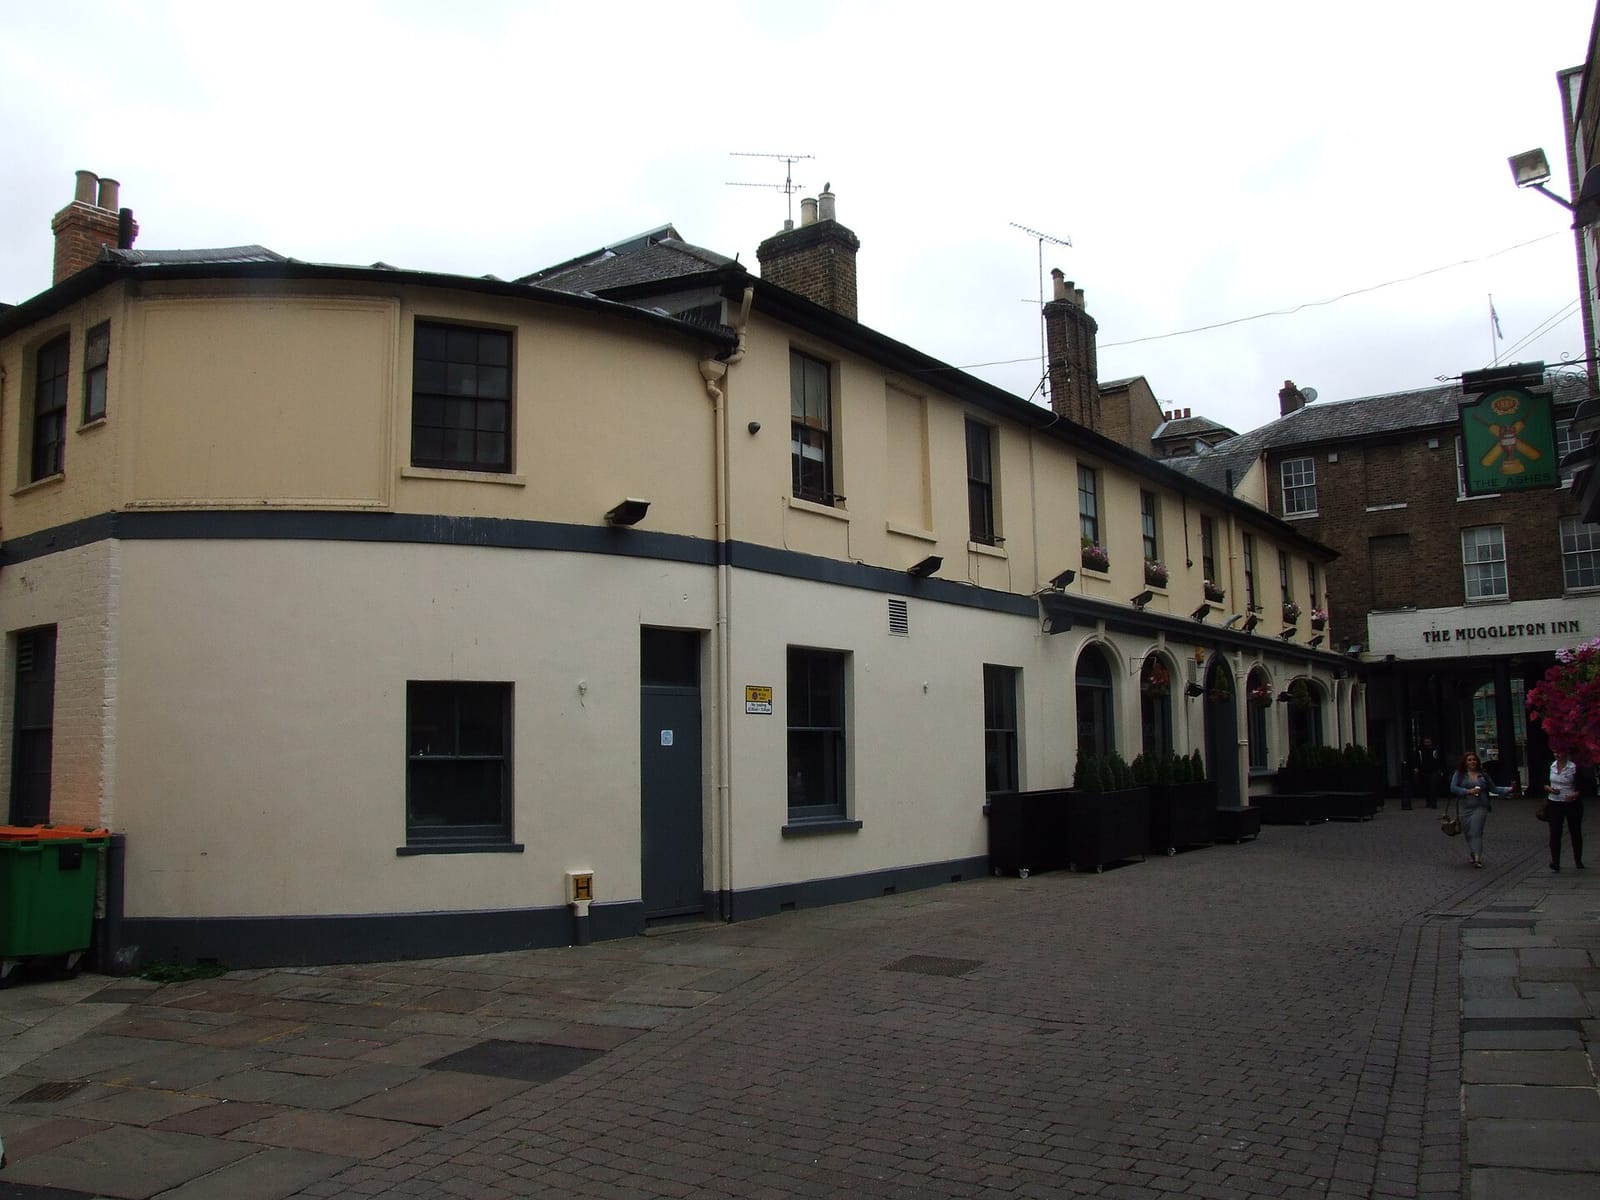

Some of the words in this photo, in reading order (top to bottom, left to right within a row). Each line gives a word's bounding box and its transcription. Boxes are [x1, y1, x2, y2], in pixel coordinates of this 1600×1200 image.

[1472, 478, 1499, 489] THE
[1504, 473, 1551, 487] ASHES
[1423, 630, 1451, 643] THE
[1456, 622, 1546, 641] MUGGLETON
[1551, 620, 1580, 634] INN
[576, 878, 590, 898] H
